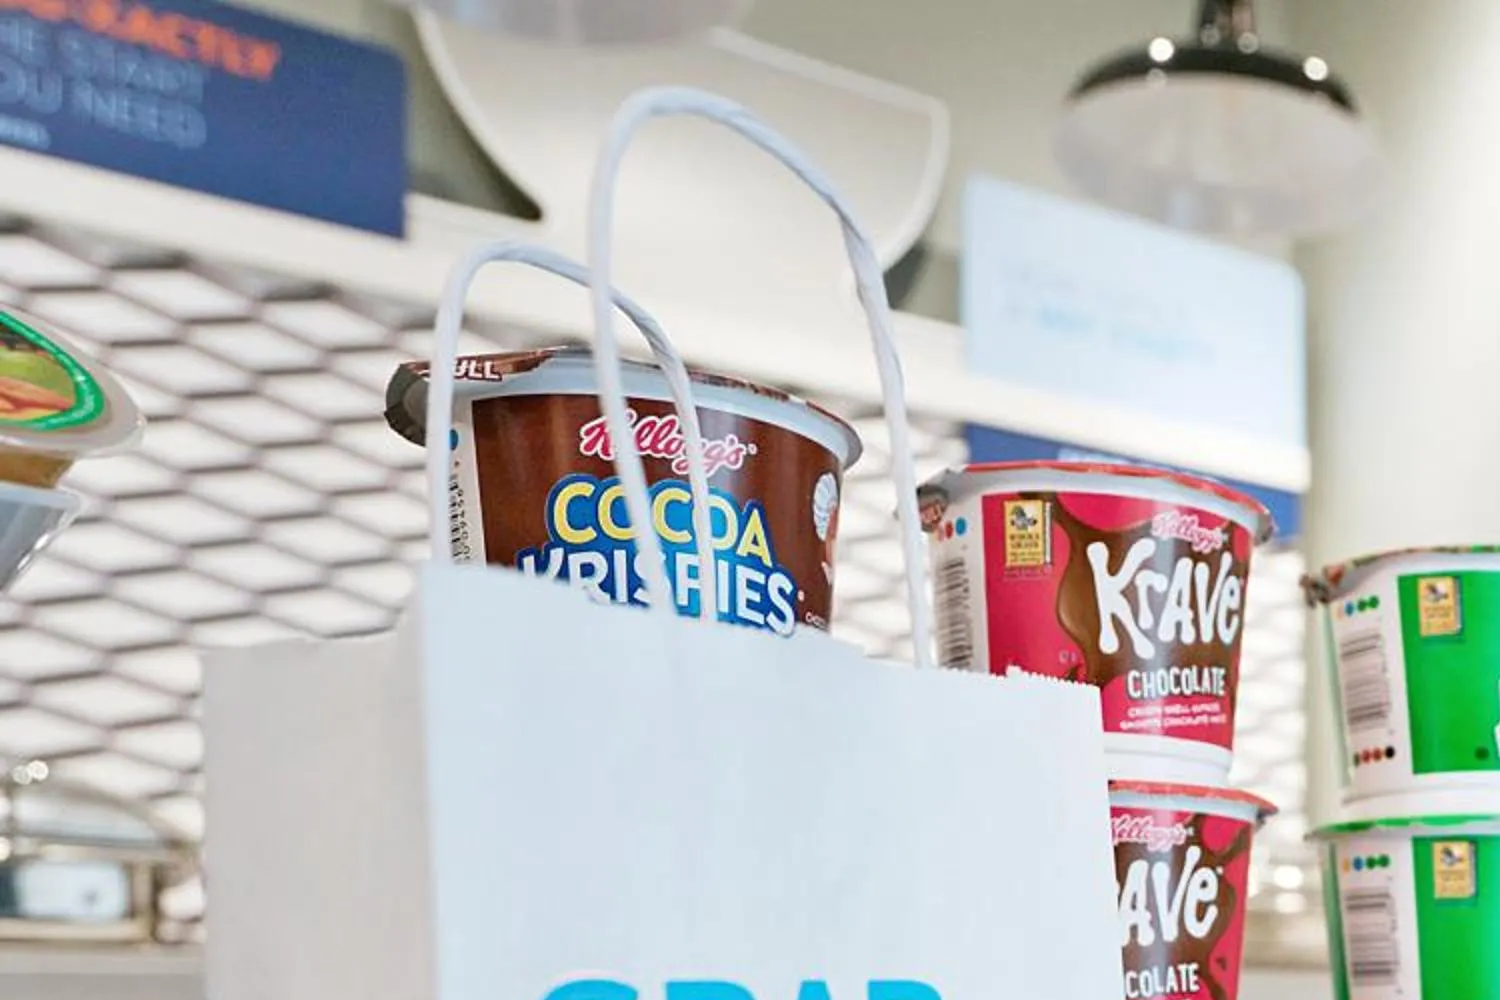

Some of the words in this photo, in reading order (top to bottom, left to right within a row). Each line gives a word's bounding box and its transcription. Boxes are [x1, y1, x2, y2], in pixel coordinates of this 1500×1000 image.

[452, 359, 500, 379] ULL
[580, 408, 748, 476] Kllog's
[552, 481, 773, 568] COCOA
[1127, 665, 1226, 699] CHOCOLATE
[1126, 962, 1201, 998] COLATE
